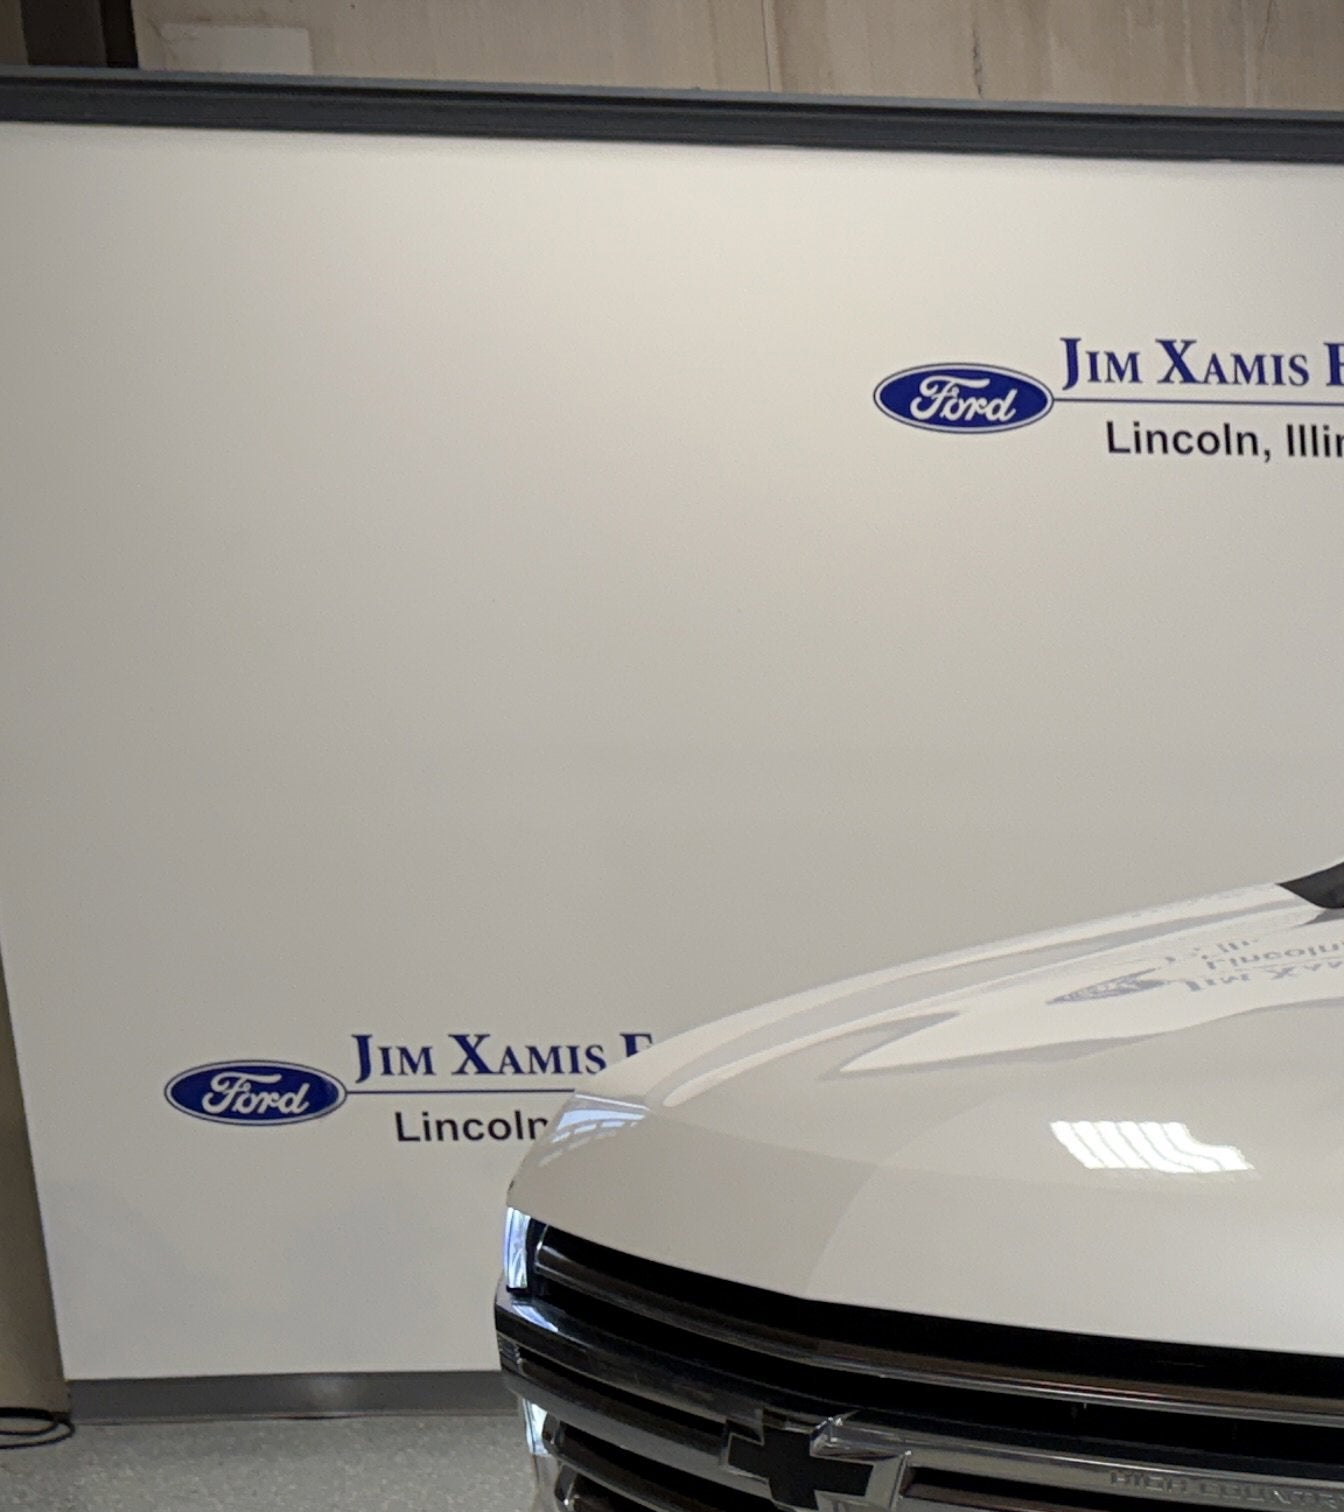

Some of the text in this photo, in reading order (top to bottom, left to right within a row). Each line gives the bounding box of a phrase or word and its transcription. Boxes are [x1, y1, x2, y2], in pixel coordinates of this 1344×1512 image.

[1059, 337, 1140, 391] JIM
[1155, 339, 1310, 387] XAMIS
[909, 373, 1017, 425] Ford
[1106, 421, 1273, 463] Lincoln,
[351, 1033, 437, 1084] JIM
[447, 1033, 607, 1077] XAMIS
[200, 1070, 311, 1116] Ford
